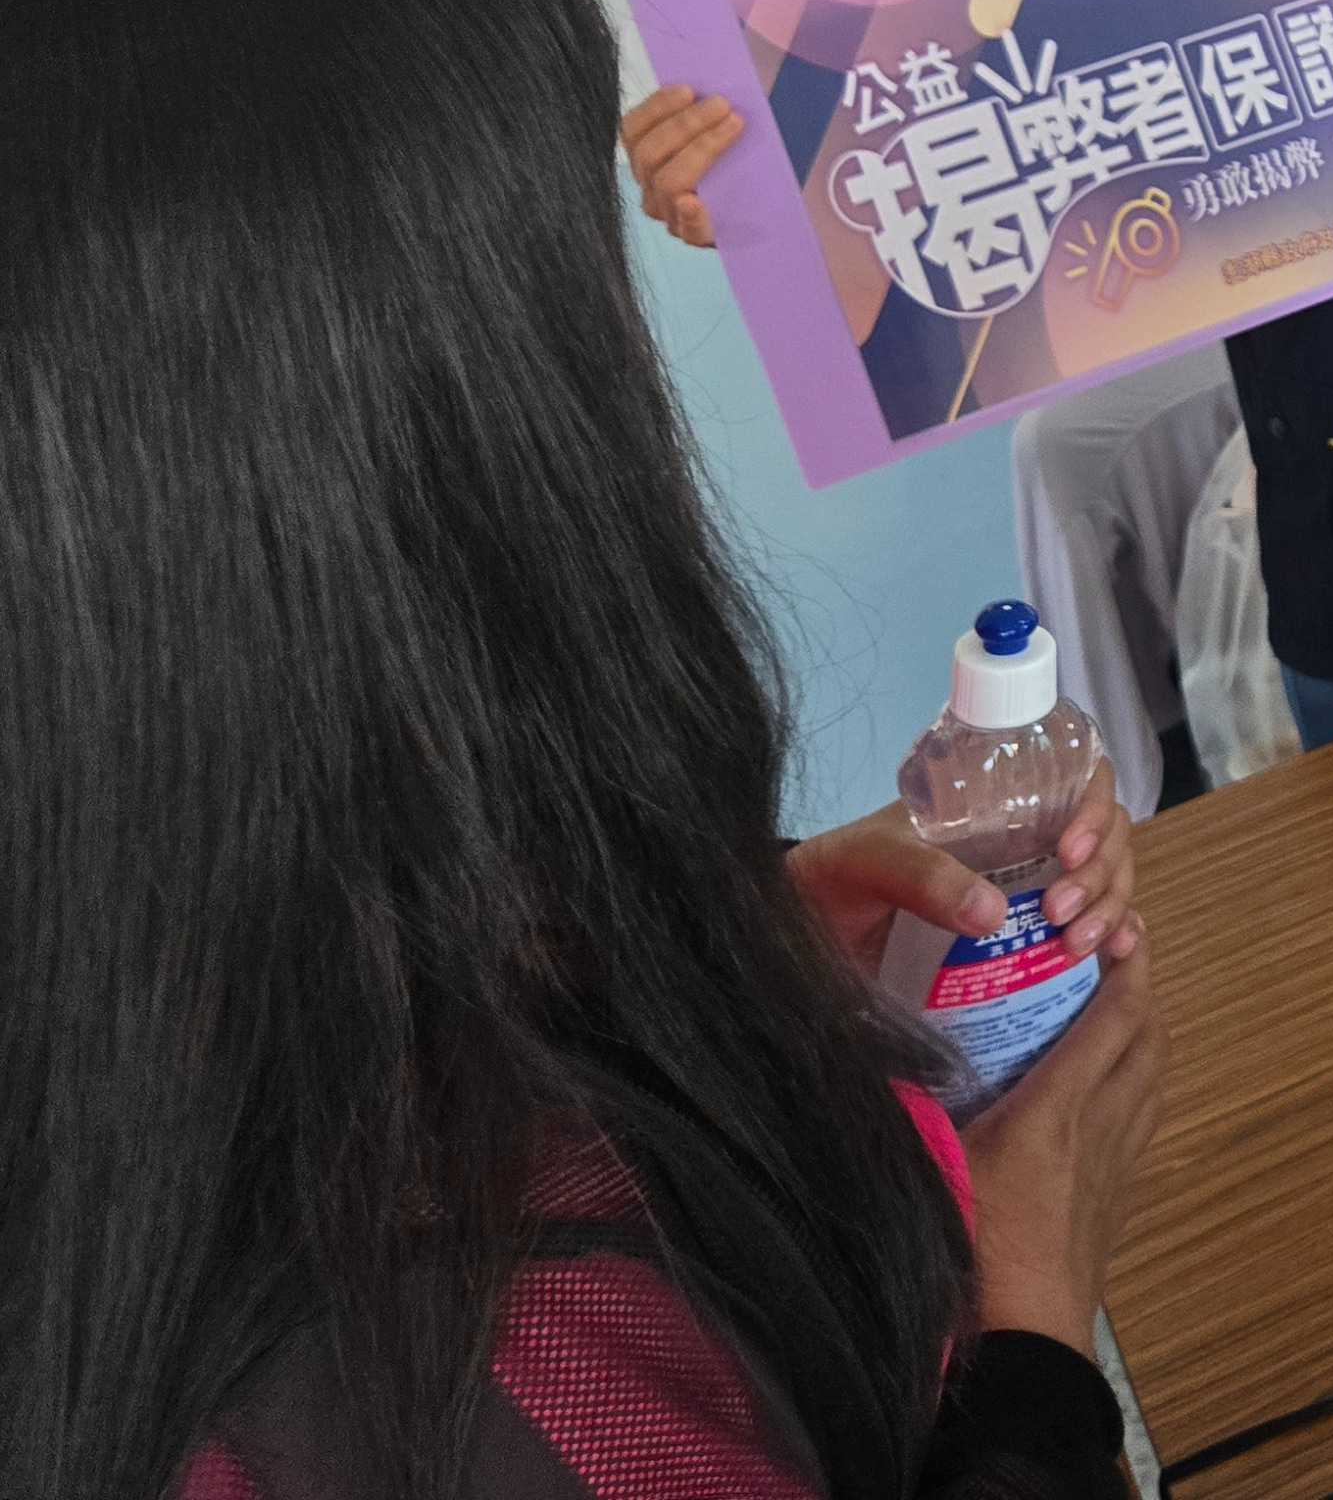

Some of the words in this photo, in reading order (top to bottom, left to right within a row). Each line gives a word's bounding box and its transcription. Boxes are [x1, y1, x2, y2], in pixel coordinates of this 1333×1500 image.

[842, 41, 968, 136] 公益
[1181, 135, 1326, 223] 勇敢揭弊
